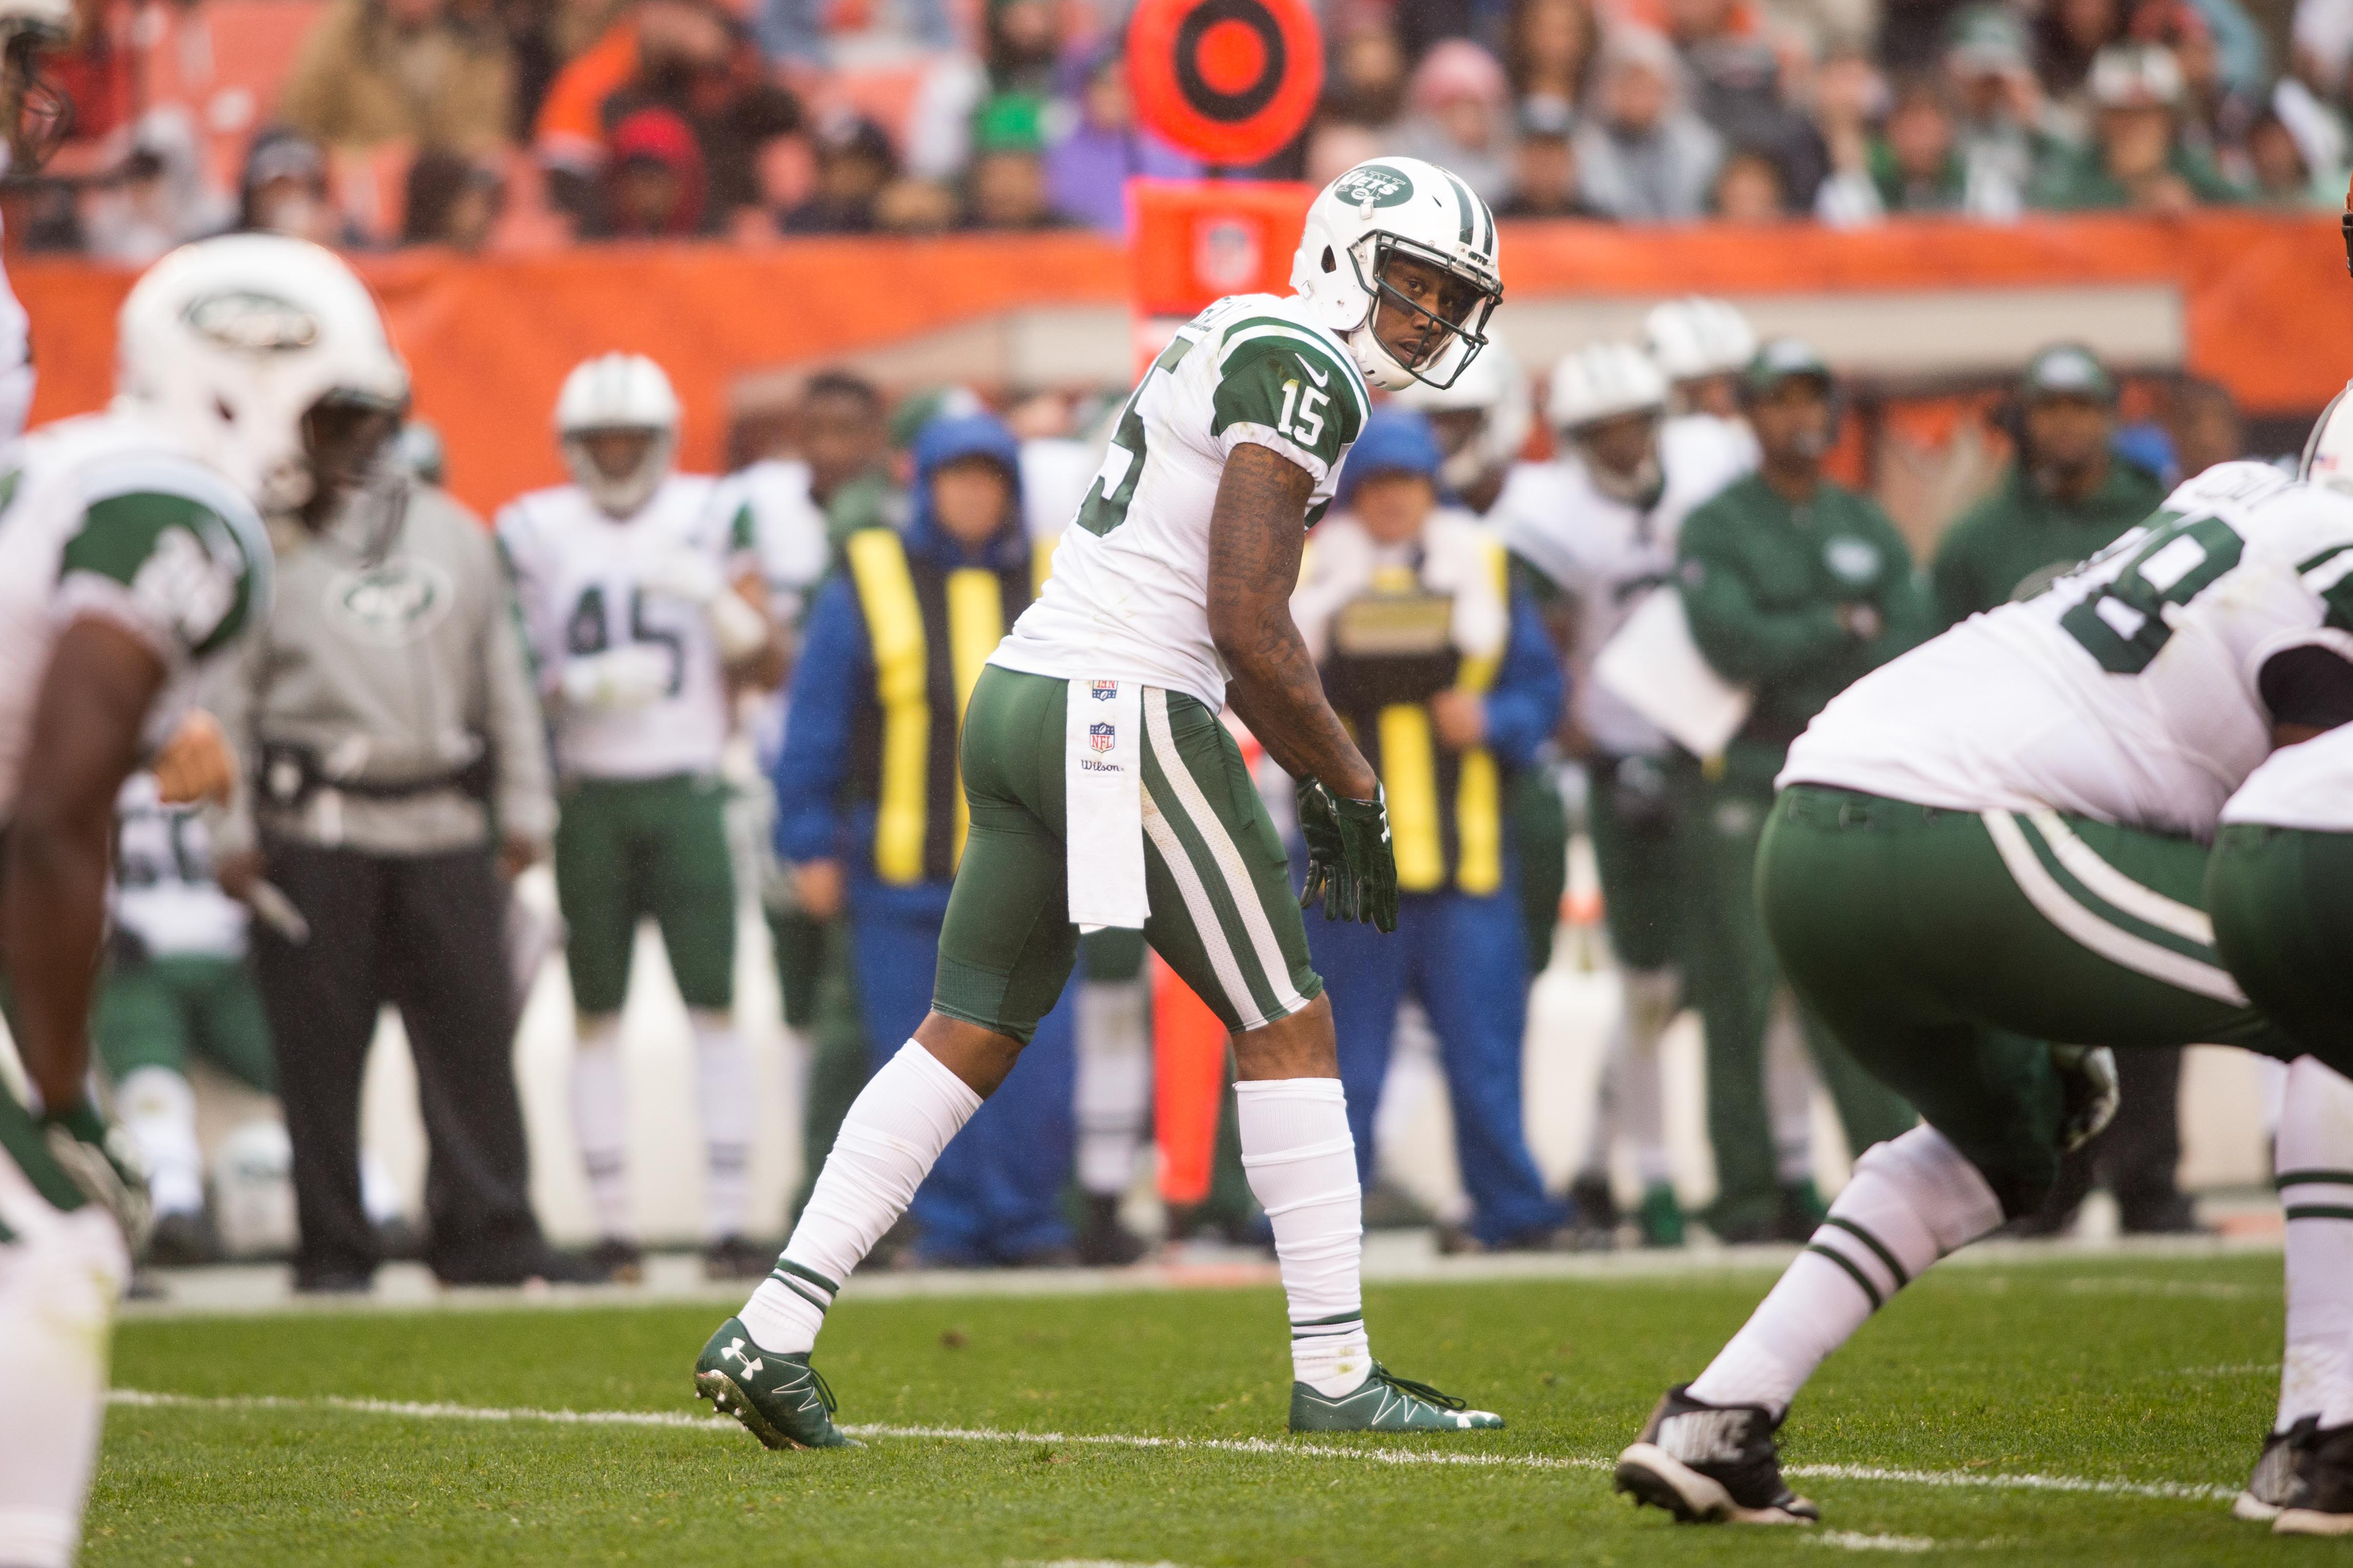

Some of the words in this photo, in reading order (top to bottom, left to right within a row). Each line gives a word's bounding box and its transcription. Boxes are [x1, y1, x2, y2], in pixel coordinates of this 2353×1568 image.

[1278, 379, 1331, 446] 15
[1092, 735, 1112, 750] NFL
[1081, 759, 1120, 772] Wilson
